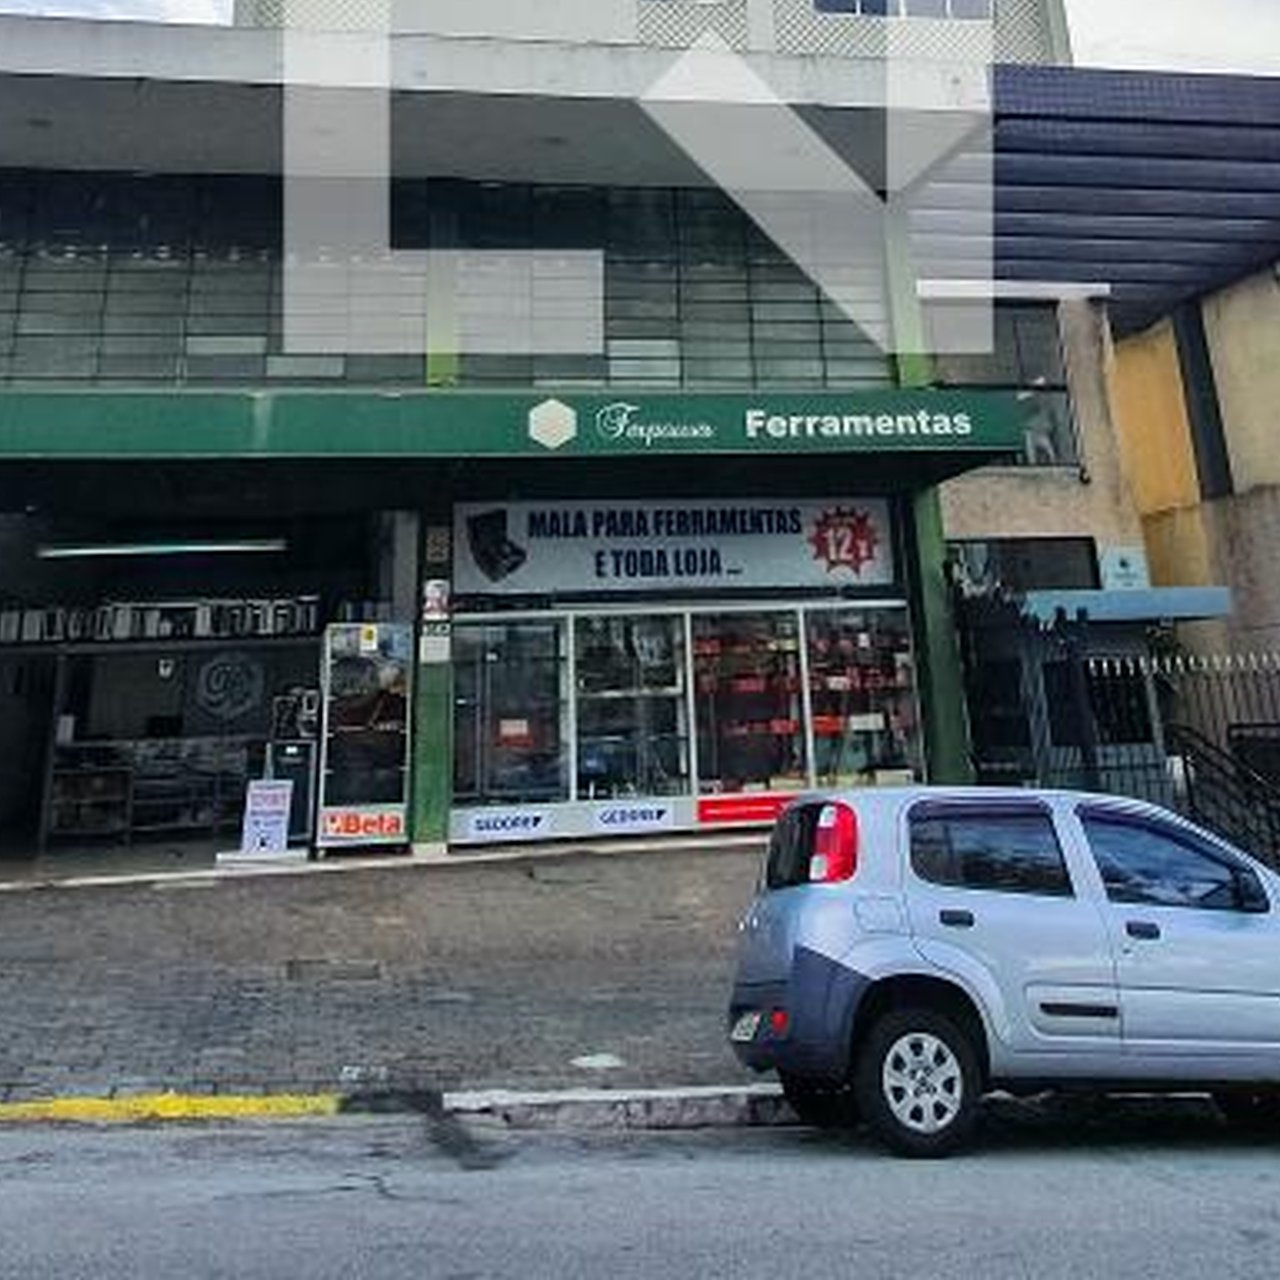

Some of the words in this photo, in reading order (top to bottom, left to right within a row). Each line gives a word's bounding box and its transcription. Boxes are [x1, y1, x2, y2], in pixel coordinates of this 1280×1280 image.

[746, 409, 972, 438] Ferramentas
[528, 509, 588, 538] MALA
[592, 508, 650, 537] PARA
[653, 507, 802, 536] FERRAMENTAS
[595, 550, 606, 577] E
[610, 549, 670, 577] TODA
[673, 549, 721, 576] LOJA
[344, 813, 402, 834] Beta
